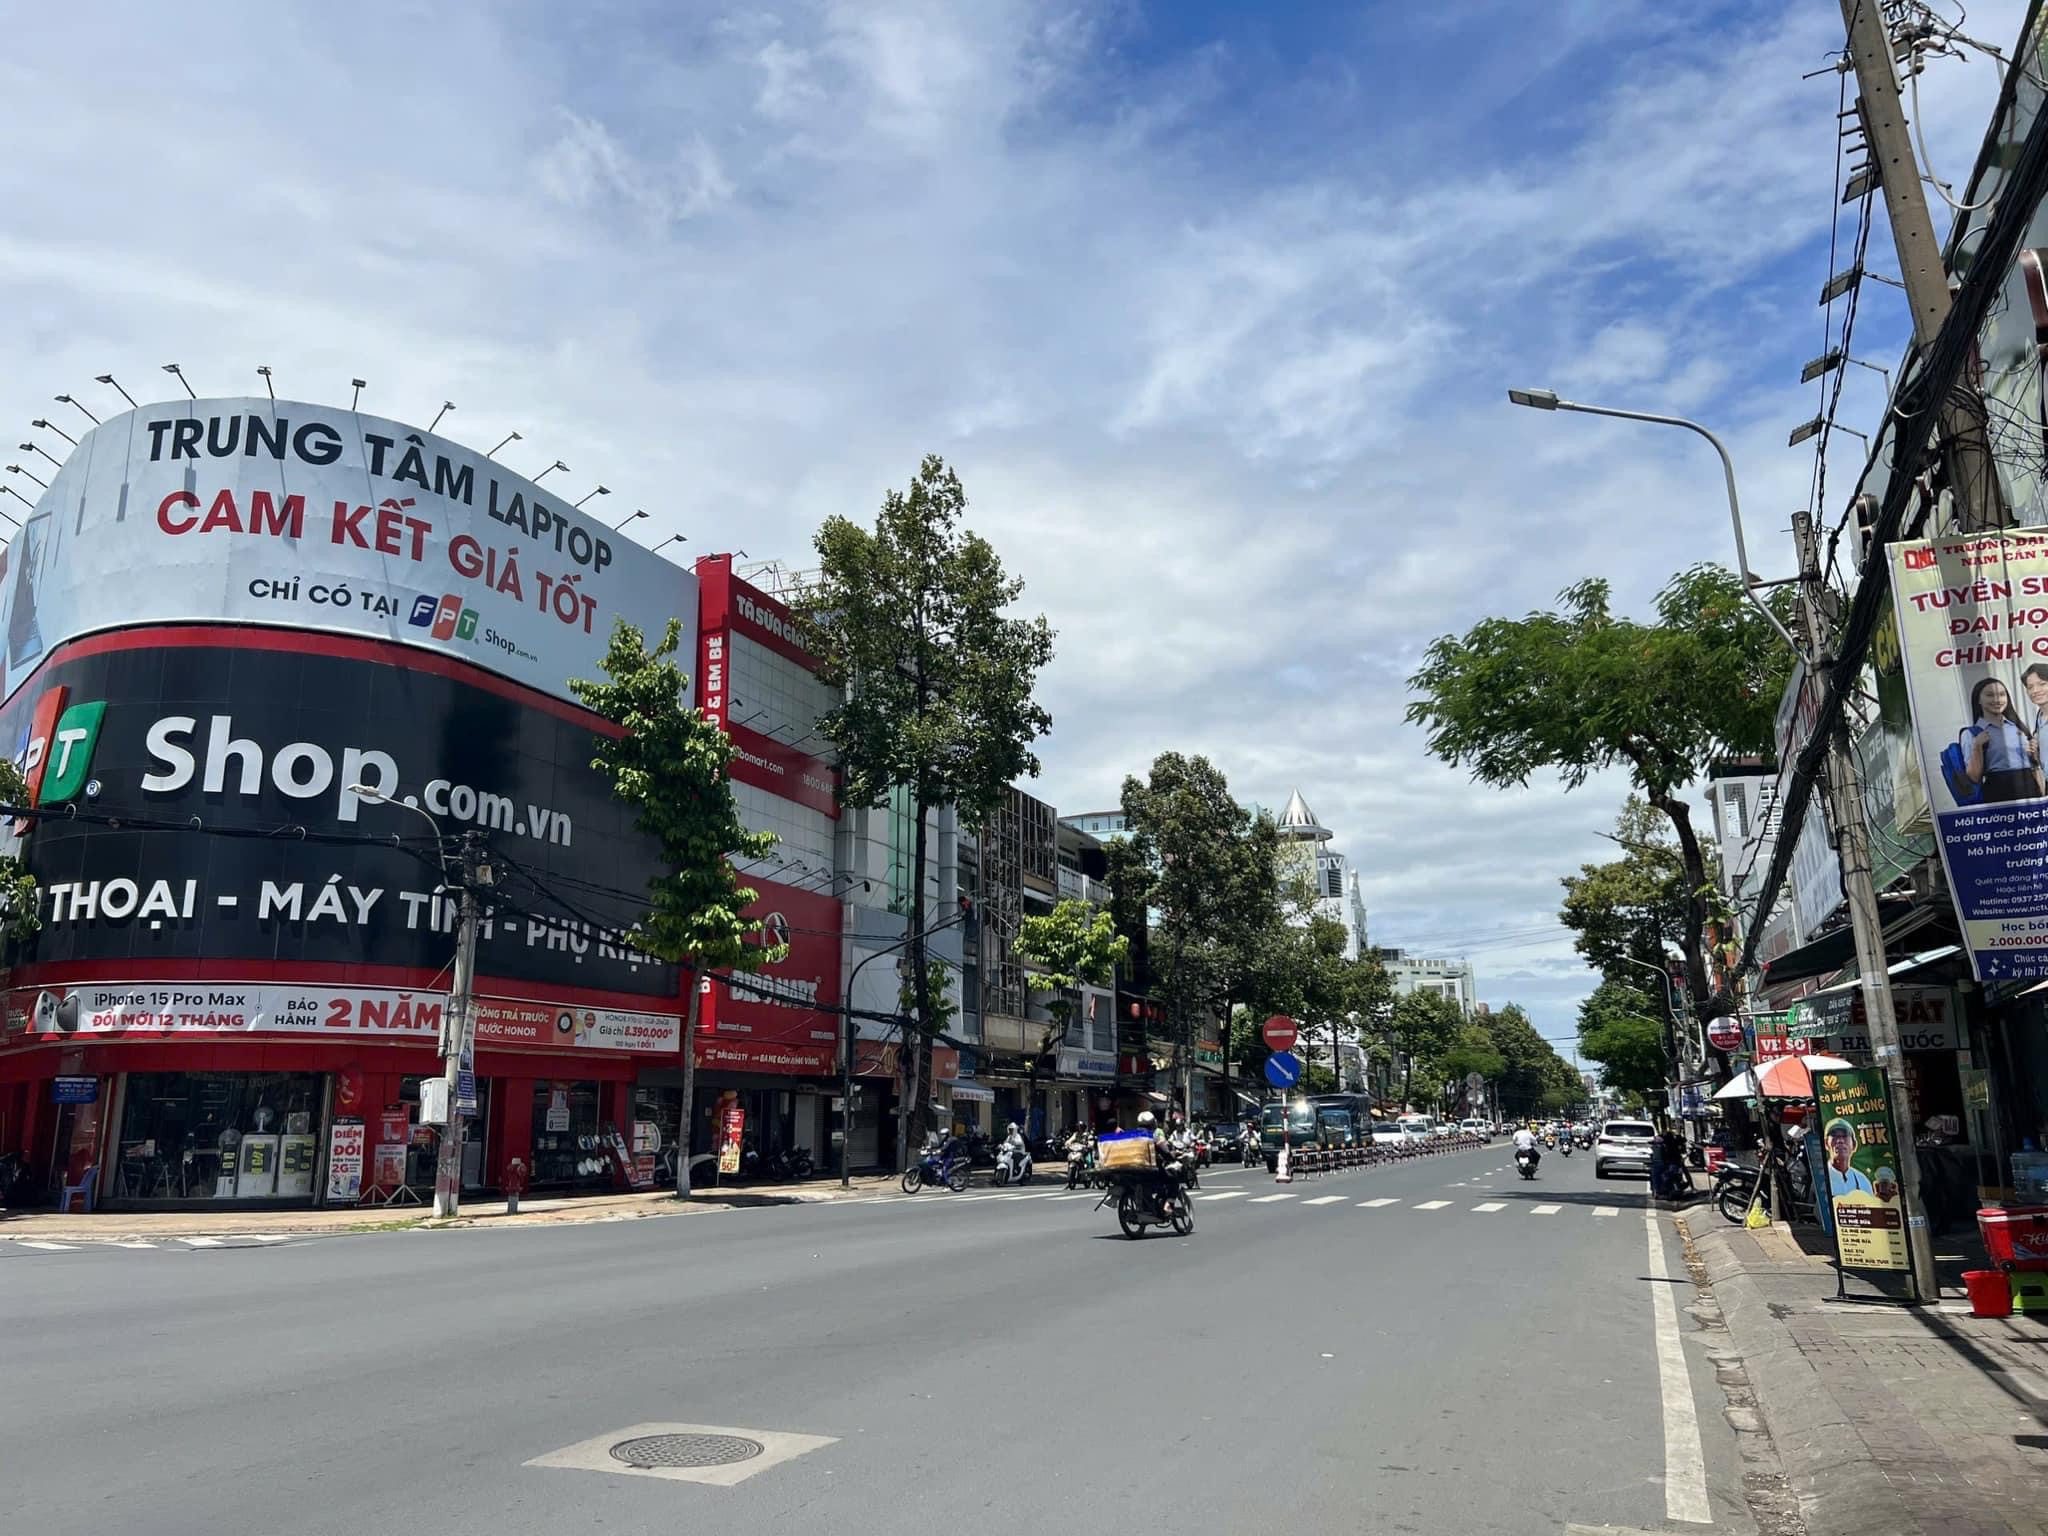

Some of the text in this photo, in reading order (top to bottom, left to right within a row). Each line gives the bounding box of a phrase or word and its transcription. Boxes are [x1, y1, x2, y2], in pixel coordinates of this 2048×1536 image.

[148, 415, 612, 574] TRUNG TÂM LAPTOP
[156, 489, 598, 635] CAM KẾT GIÁ TỐT
[1961, 554, 1998, 567] NAM
[1910, 577, 2012, 612] TUYỂN
[249, 575, 479, 638] CHỈ CÓ TẠI FPT
[1949, 614, 1999, 638] ĐẠI
[1935, 642, 2023, 668] CHÍNH
[707, 664, 722, 692] EM
[2018, 810, 2040, 821] học
[1963, 831, 1991, 843] dạng
[1994, 828, 2015, 839] các
[49, 880, 197, 930] THOẠI
[257, 874, 384, 925] MÁY
[526, 913, 589, 963] PHỤ
[2001, 922, 2025, 936] Học
[94, 992, 245, 1007] iPhone 15 Pro Max
[121, 1012, 153, 1027] MỚI
[158, 1014, 173, 1026] 12
[179, 1012, 245, 1027] THÁNG
[274, 1012, 317, 1027] HÀNH
[287, 992, 442, 1031] BẢO 2 NĂM
[504, 1025, 537, 1037] HONOR
[1841, 1030, 1945, 1049] HÀ UỐC
[1856, 1098, 1885, 1114] LONG
[1859, 1127, 1889, 1145] 15K
